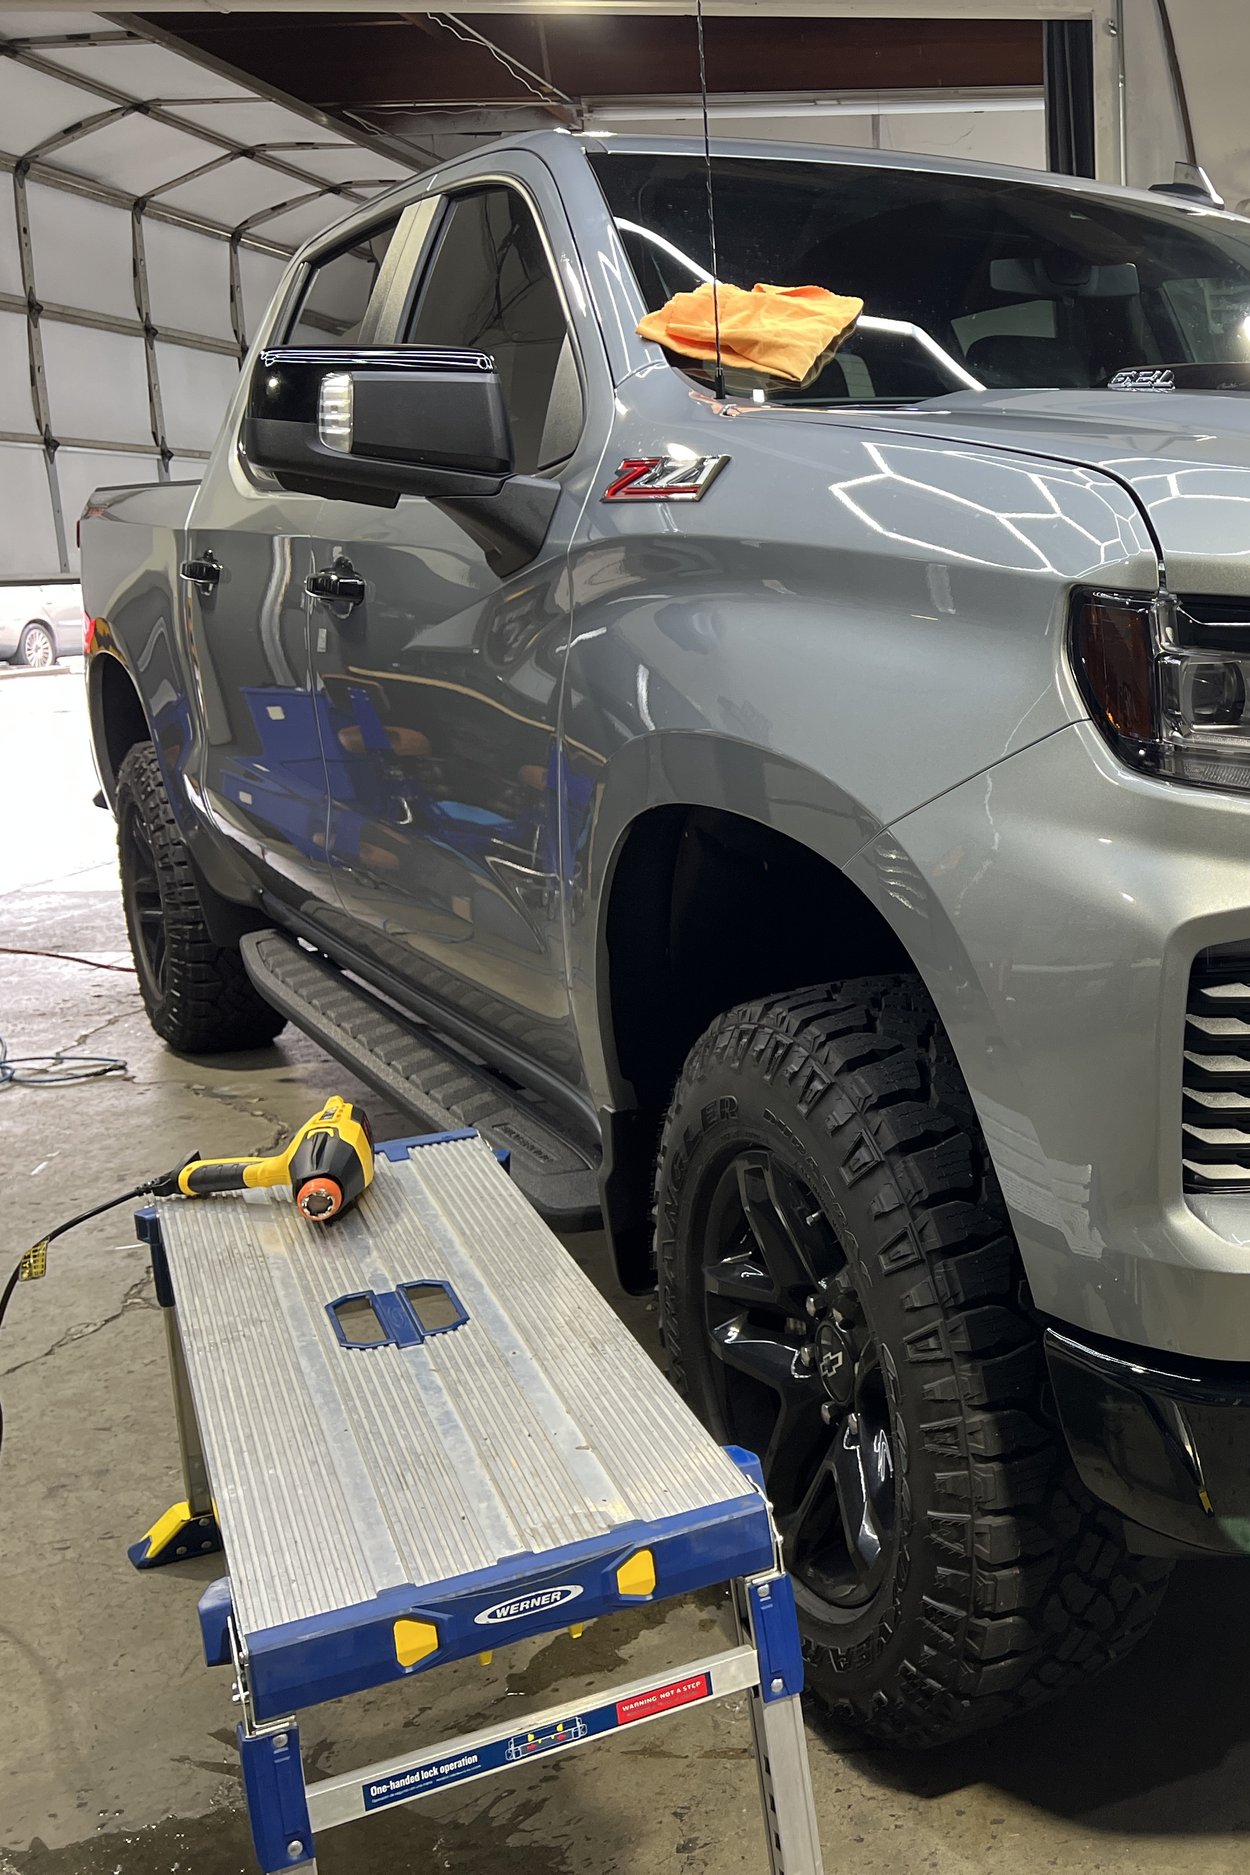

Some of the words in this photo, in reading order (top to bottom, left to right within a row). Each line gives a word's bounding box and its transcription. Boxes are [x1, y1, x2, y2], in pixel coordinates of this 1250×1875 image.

[601, 454, 731, 503] Z71
[495, 1591, 562, 1618] WERNER
[622, 1696, 657, 1711] WARNING
[659, 1690, 674, 1700] NOT
[683, 1681, 701, 1692] STEP
[370, 1771, 420, 1797] One-handed
[420, 1766, 439, 1780] lock
[439, 1754, 478, 1775] operation
